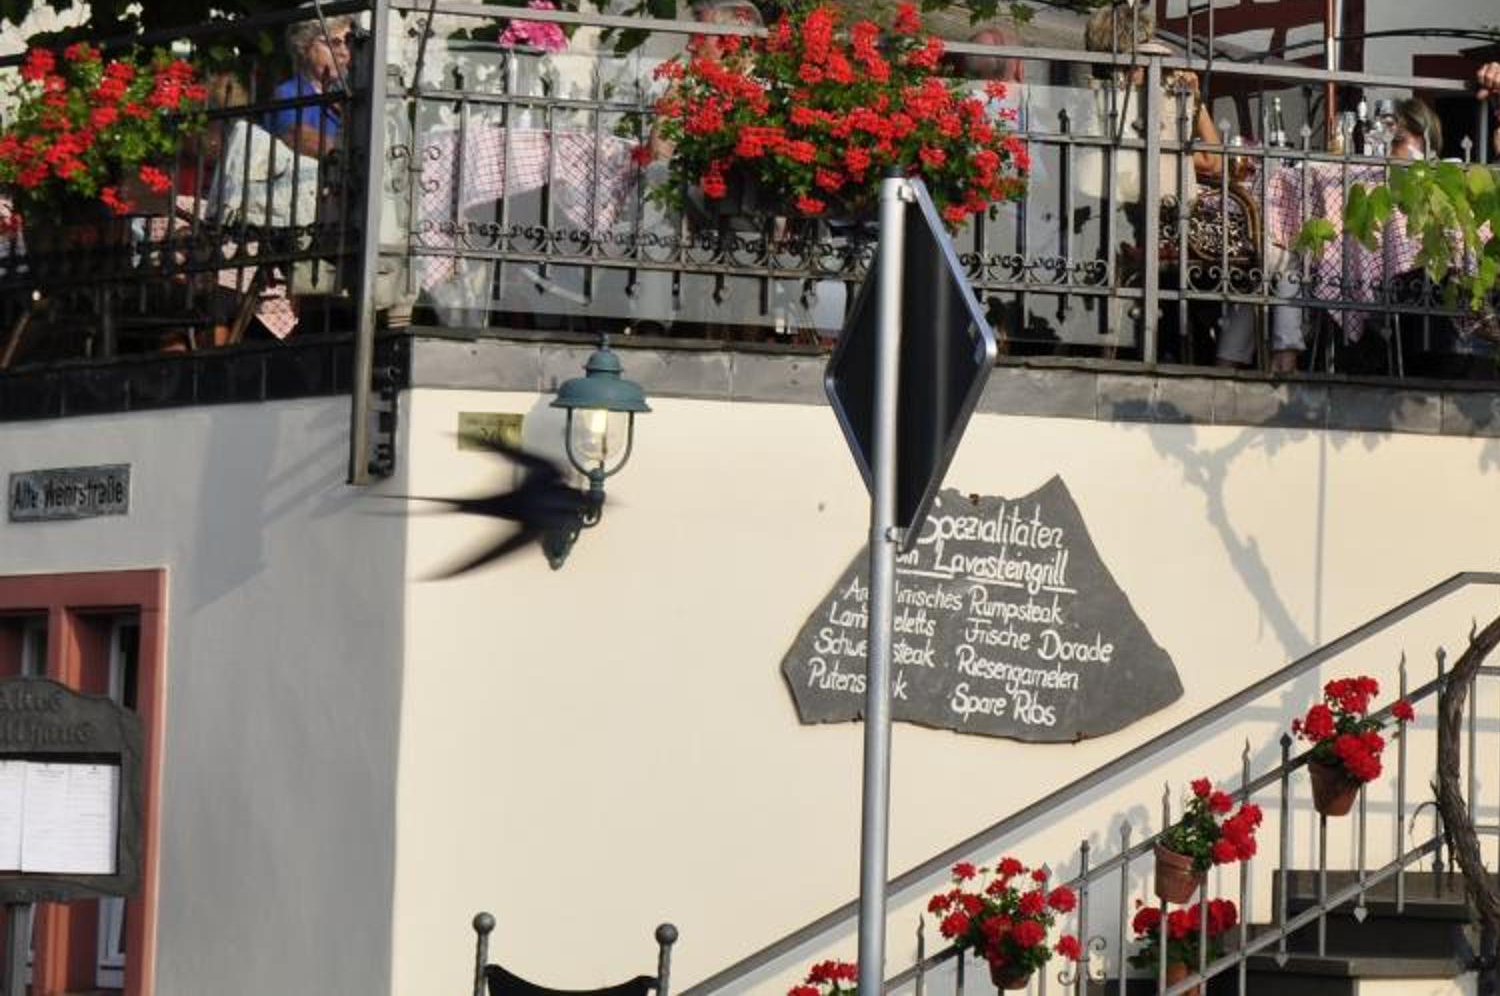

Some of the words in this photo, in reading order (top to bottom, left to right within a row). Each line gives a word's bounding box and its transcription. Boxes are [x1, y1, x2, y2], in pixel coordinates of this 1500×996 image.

[933, 544, 1070, 595] Lavasteingrill
[969, 584, 1064, 625] Rumpsteak
[965, 617, 1031, 651] Frische
[1037, 629, 1114, 663] Dorade
[951, 683, 1007, 723] Spare
[1012, 688, 1057, 726] Ribs
